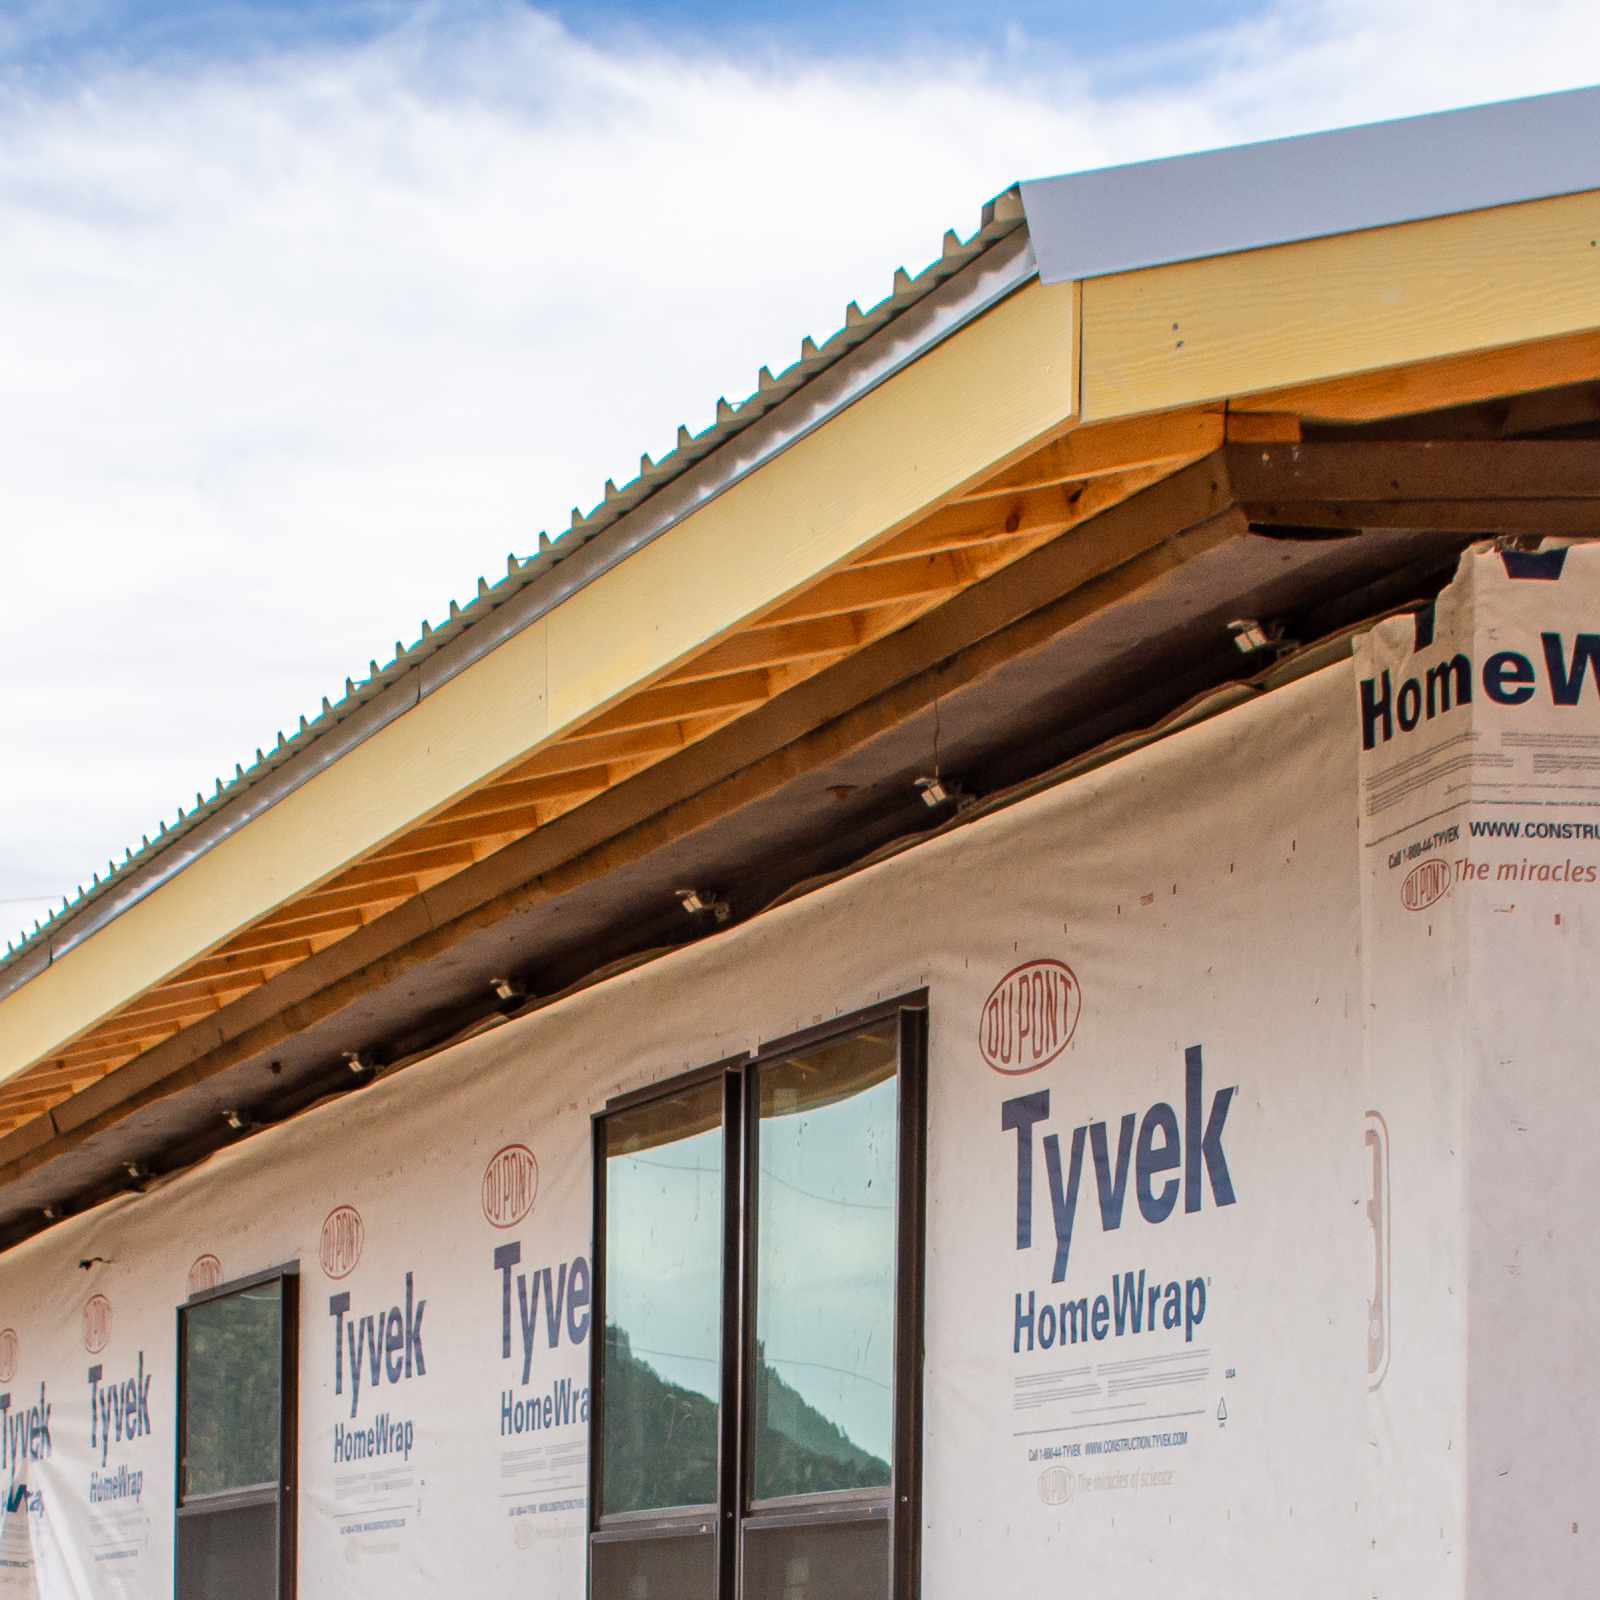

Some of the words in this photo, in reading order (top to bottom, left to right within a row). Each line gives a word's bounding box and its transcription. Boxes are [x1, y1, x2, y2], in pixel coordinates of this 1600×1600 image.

[1455, 857, 1490, 883] The
[1496, 858, 1597, 883] miracles
[1002, 1045, 1238, 1284] Tyvek
[329, 1271, 427, 1418] Tyvek
[1013, 1269, 1207, 1354] HomeWrap
[0, 1381, 52, 1486] Tyvek
[88, 1351, 152, 1467] Tyvek
[334, 1412, 414, 1463] HomeWrap
